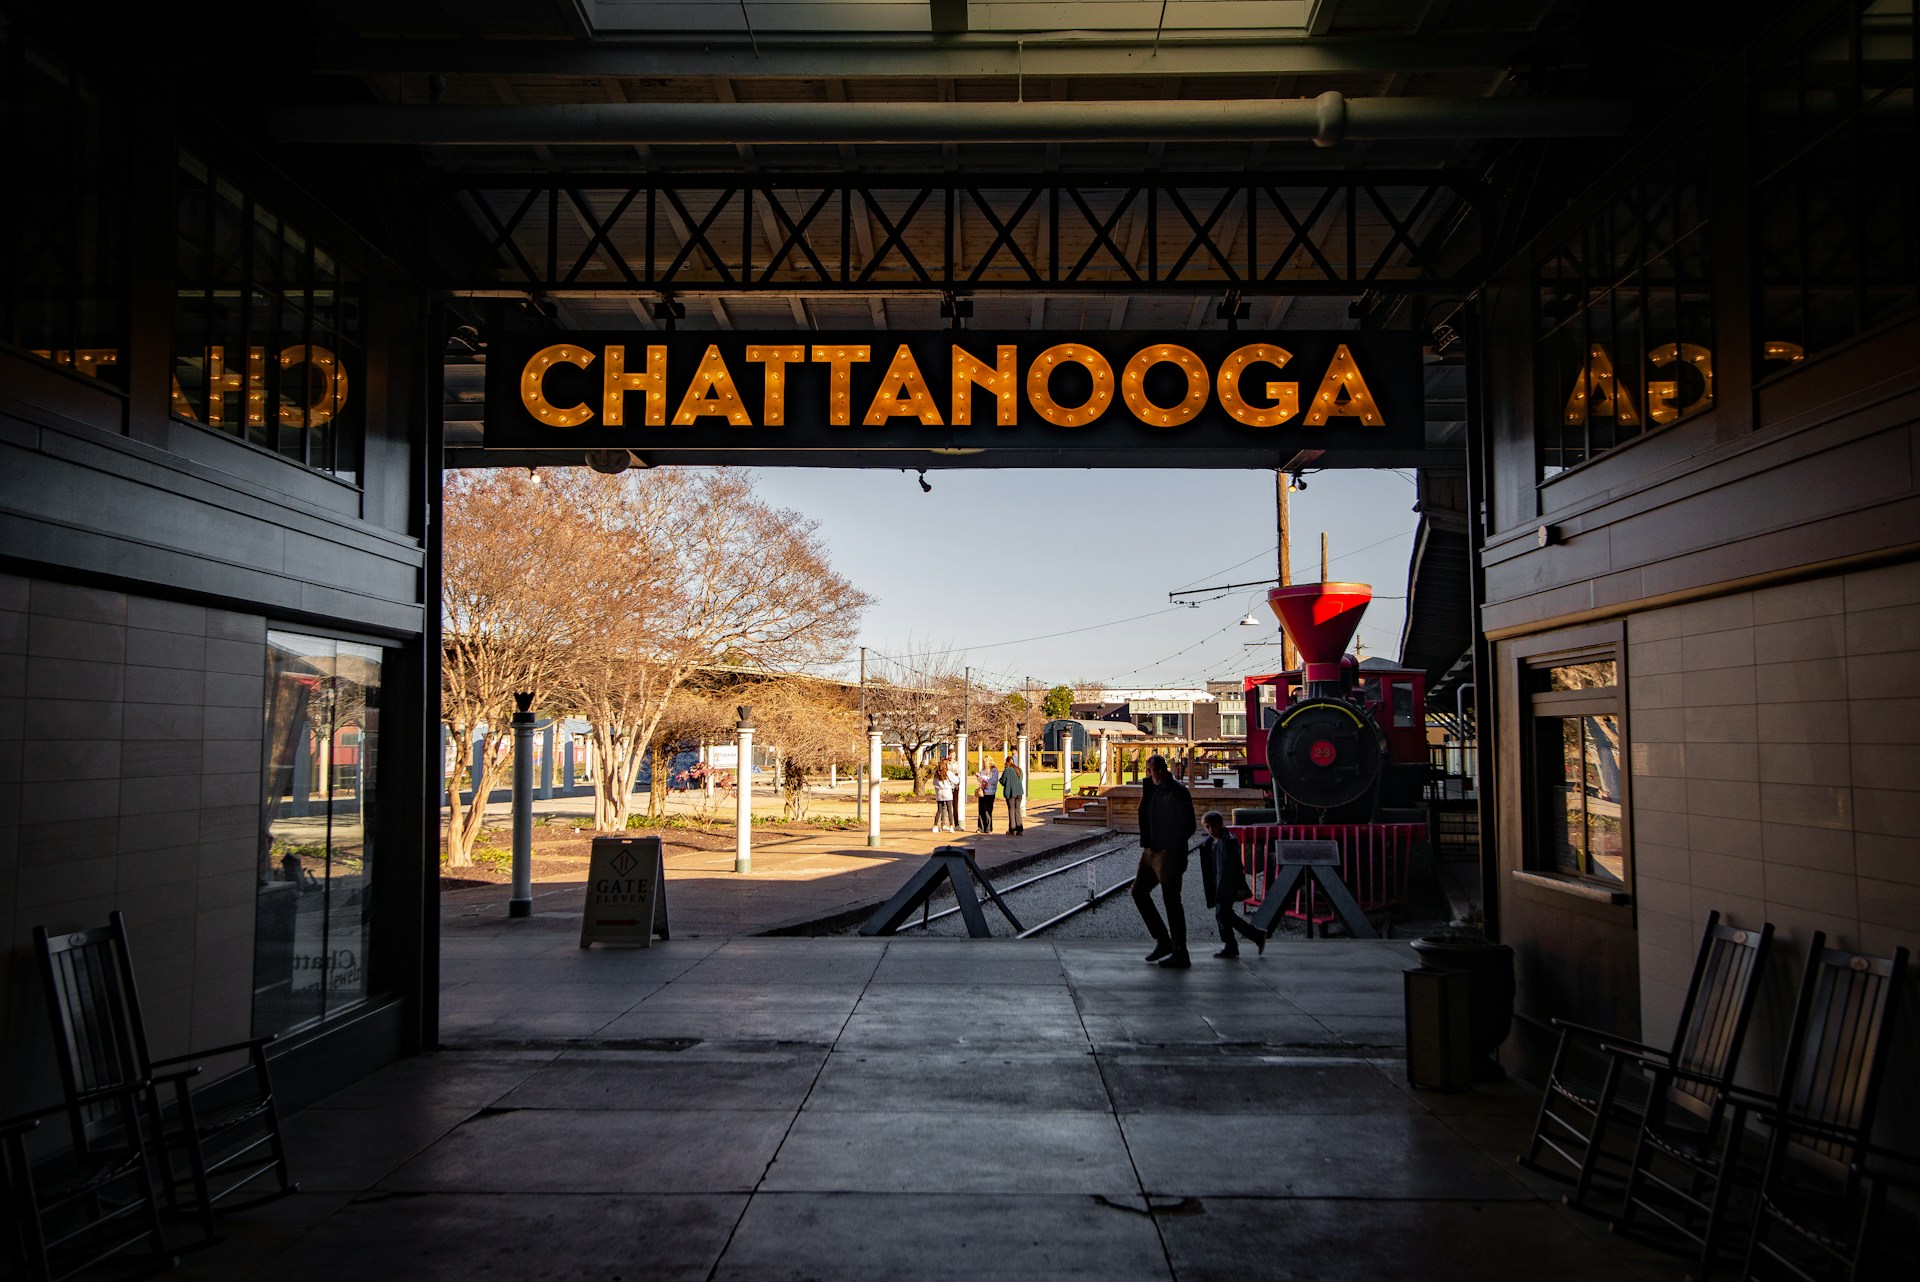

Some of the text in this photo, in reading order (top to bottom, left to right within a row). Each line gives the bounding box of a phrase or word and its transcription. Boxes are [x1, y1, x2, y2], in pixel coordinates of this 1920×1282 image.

[520, 343, 1386, 428] CHATTANOOGA
[1315, 747, 1331, 758] 29
[596, 879, 648, 893] GATE
[595, 895, 646, 904] ELEVEN
